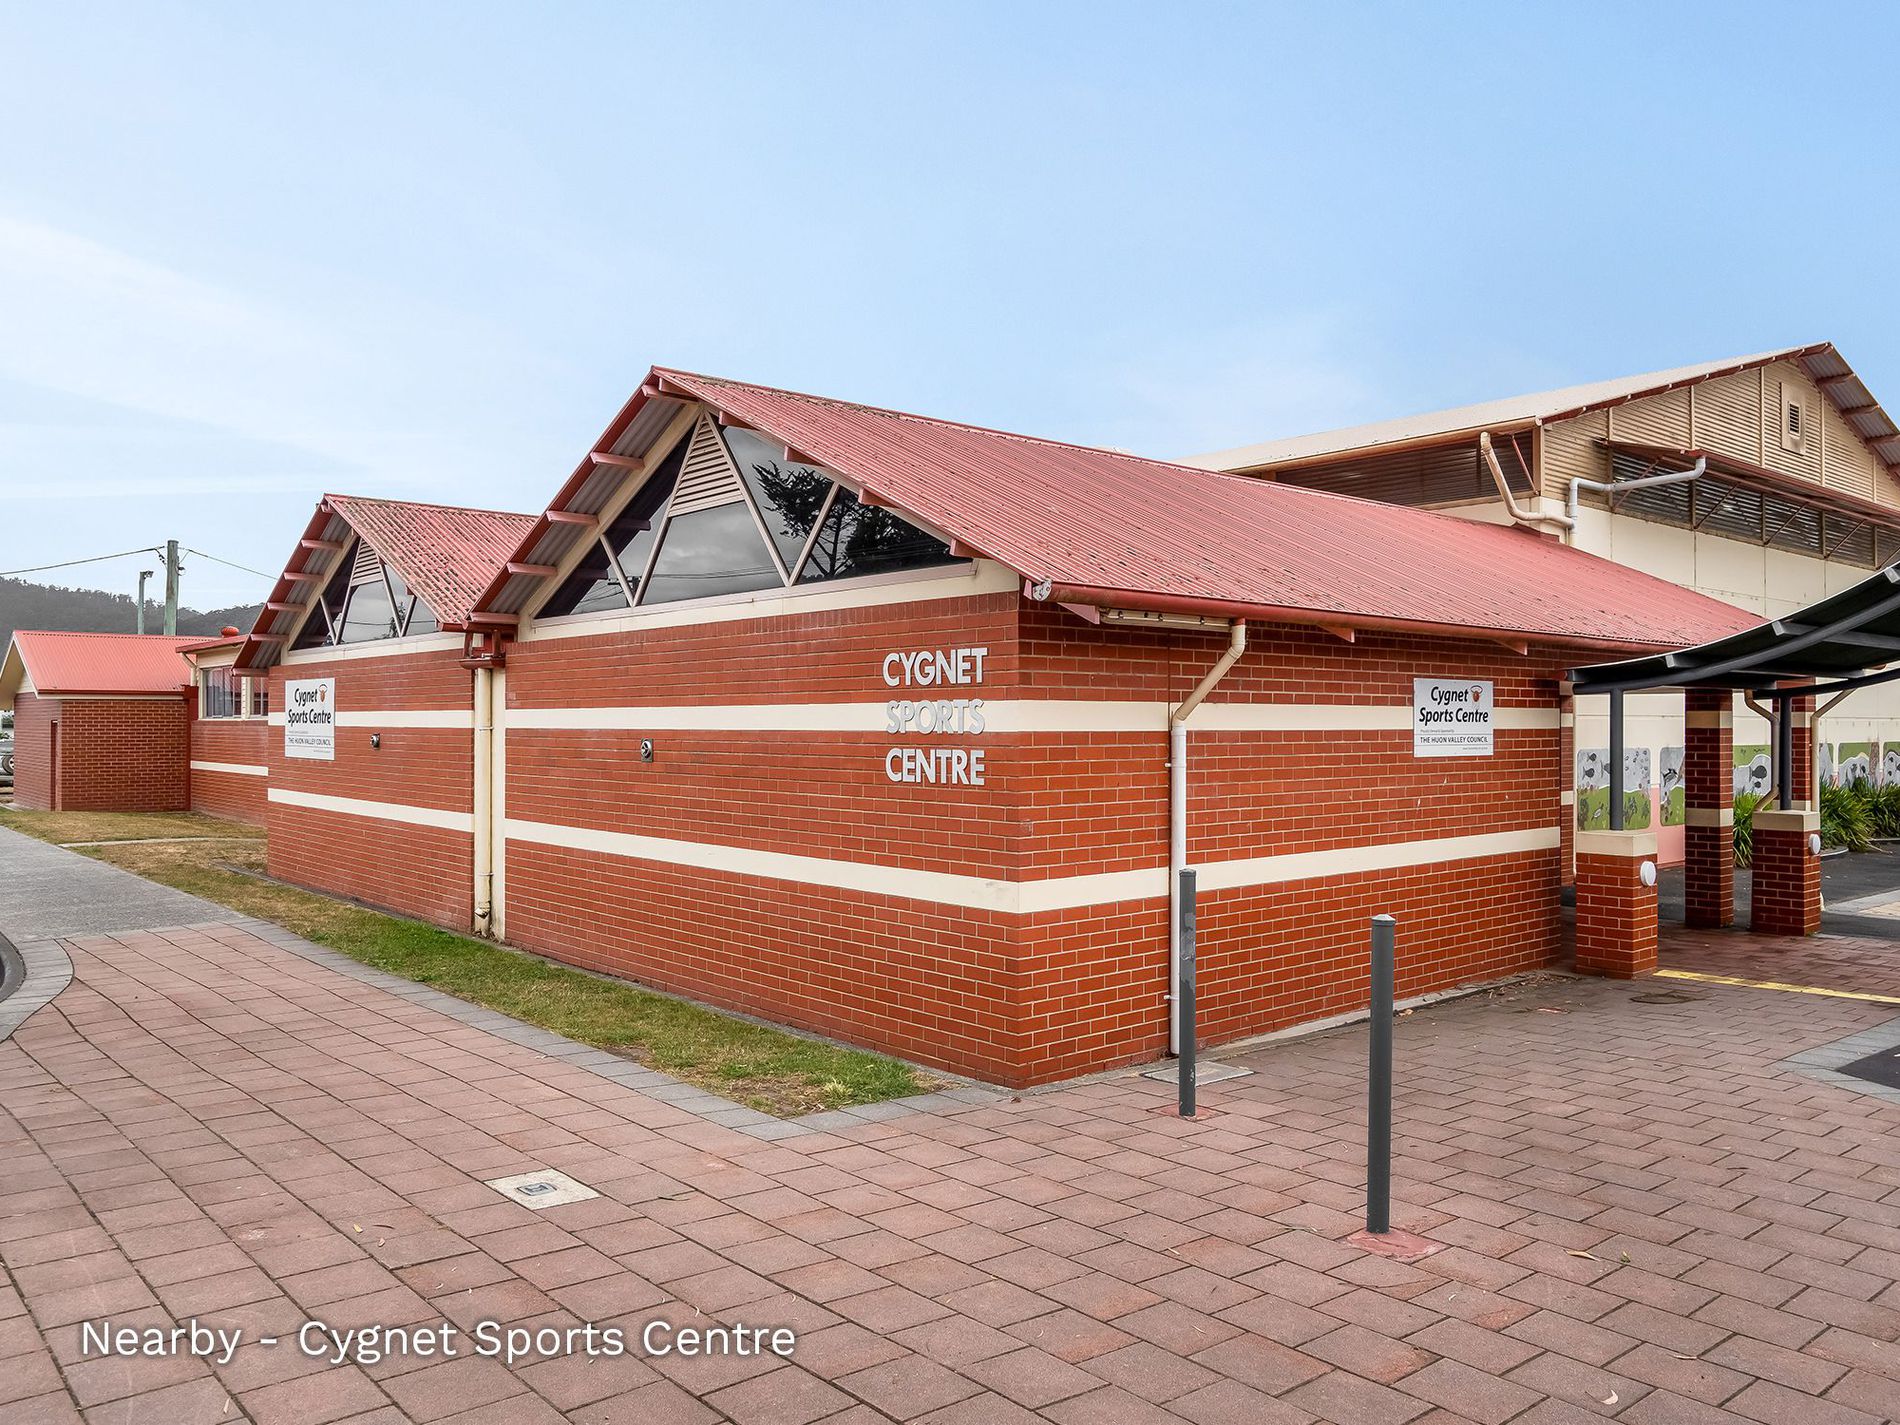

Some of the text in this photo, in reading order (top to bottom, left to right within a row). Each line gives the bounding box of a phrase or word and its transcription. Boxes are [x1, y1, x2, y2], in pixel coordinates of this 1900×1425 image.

[882, 647, 988, 687] CYGNET
[294, 687, 318, 707] Cygnet
[1430, 686, 1469, 706] Cygnet
[288, 708, 332, 727] Sports Centre
[886, 698, 985, 735] SPORTS
[1419, 707, 1489, 726] Sports Centre
[1420, 736, 1431, 744] THE
[885, 747, 985, 786] CENTRE
